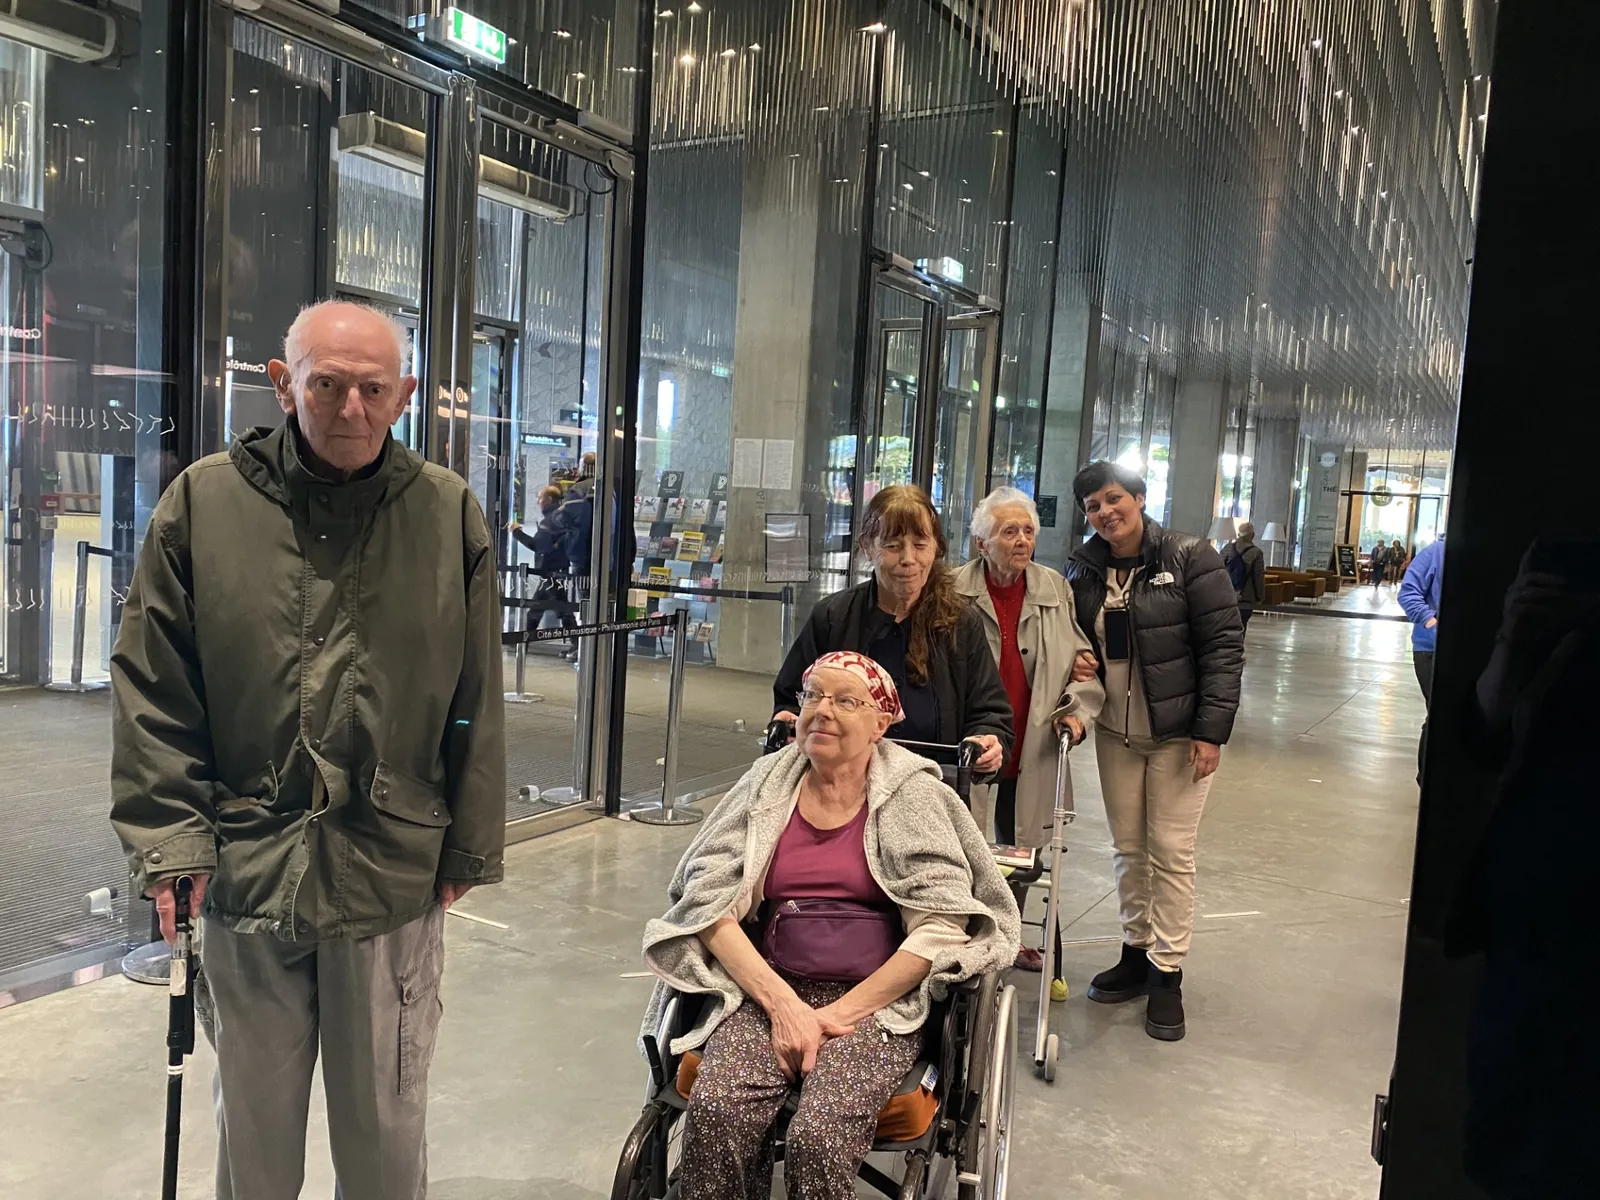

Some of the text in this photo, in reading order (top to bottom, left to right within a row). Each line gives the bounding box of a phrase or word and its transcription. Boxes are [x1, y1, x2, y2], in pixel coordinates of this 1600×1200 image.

[537, 630, 552, 639] Cité
[553, 629, 562, 638] de
[563, 628, 569, 636] la
[570, 626, 597, 635] musique
[601, 620, 639, 632] Philharmonie
[640, 619, 647, 627] de
[648, 618, 661, 627] Paris
